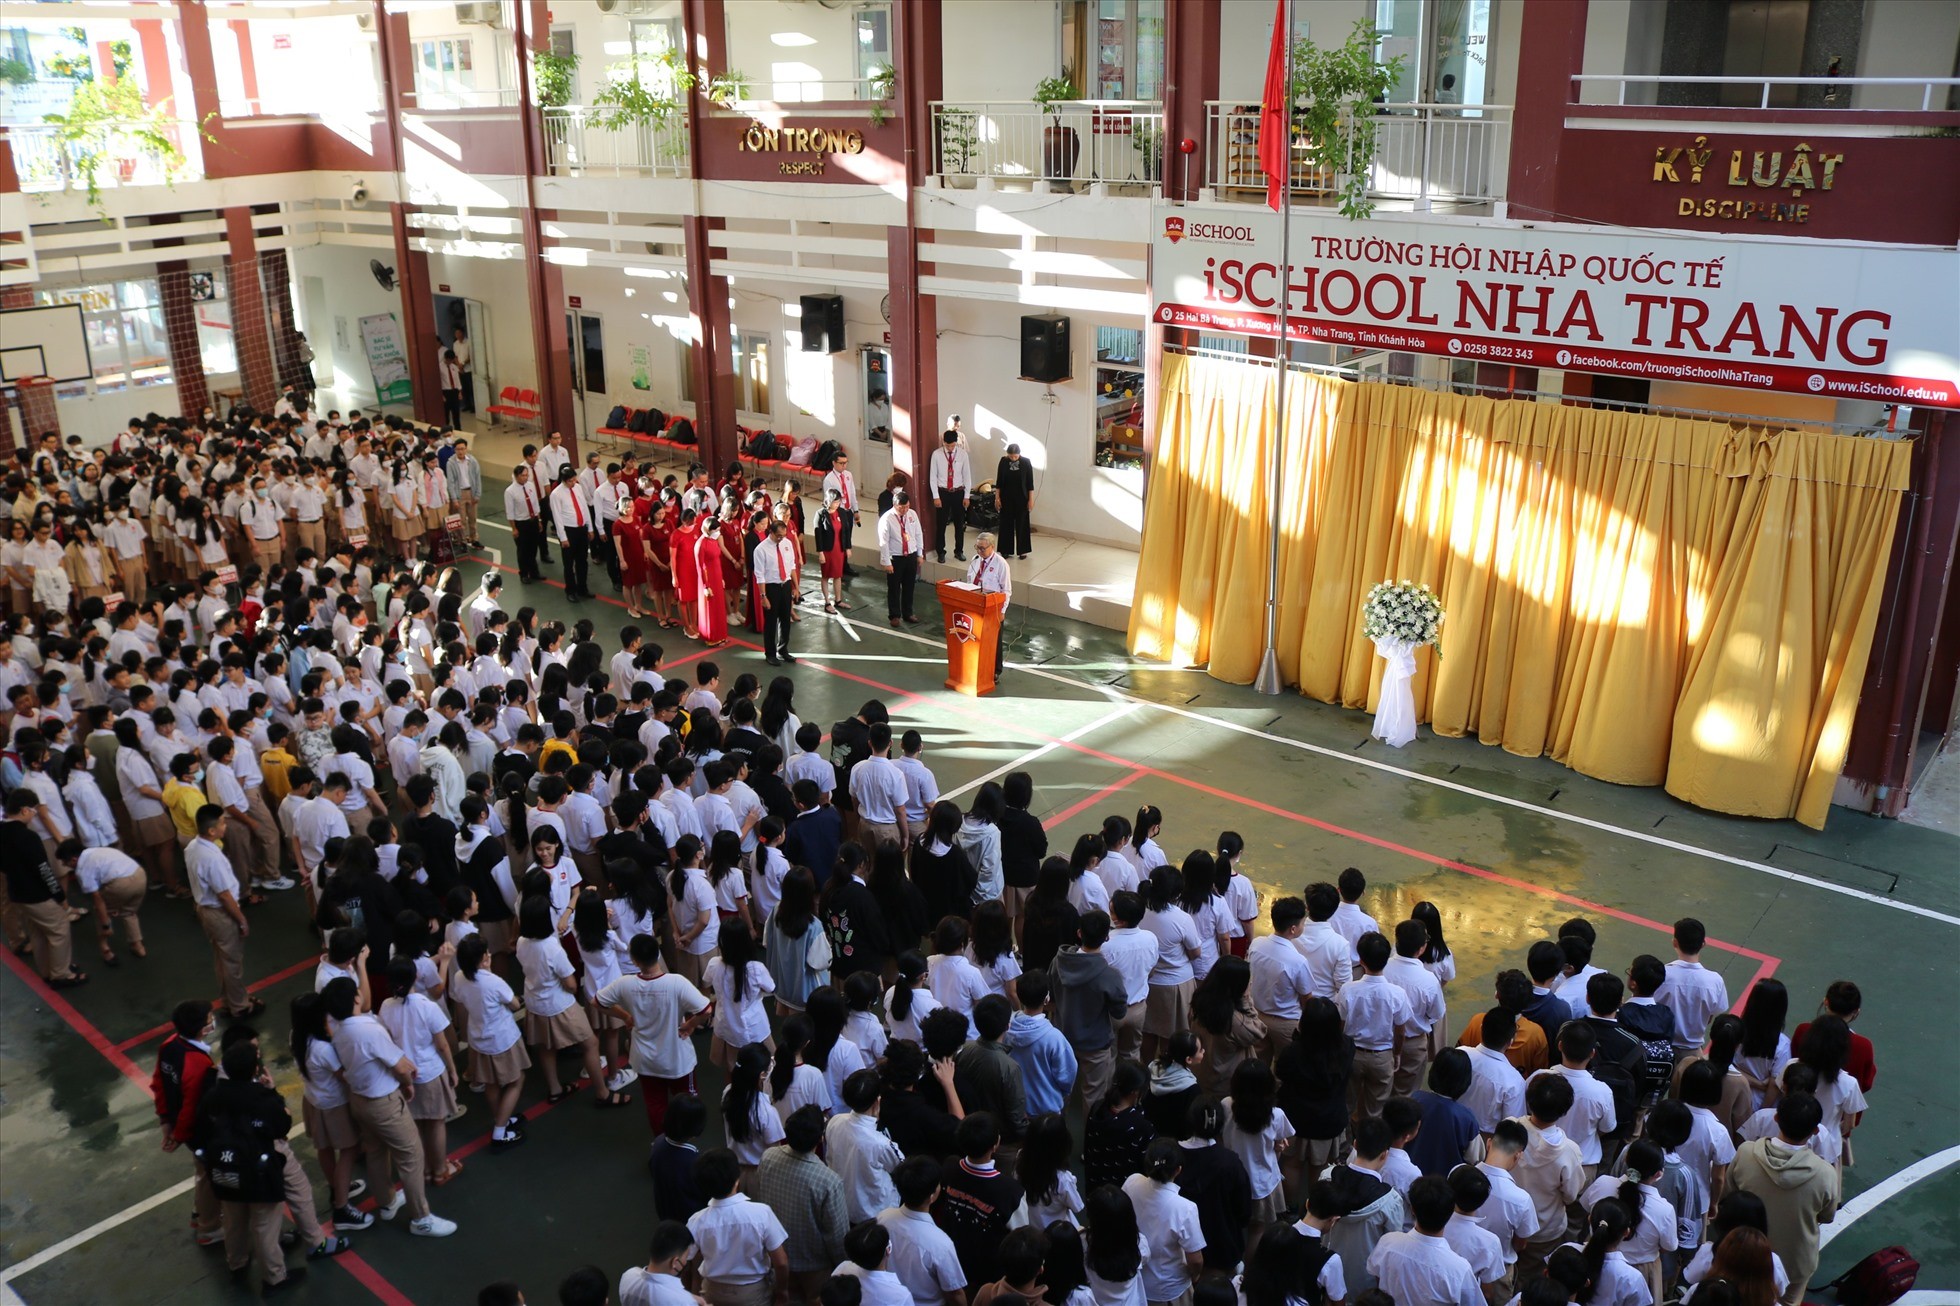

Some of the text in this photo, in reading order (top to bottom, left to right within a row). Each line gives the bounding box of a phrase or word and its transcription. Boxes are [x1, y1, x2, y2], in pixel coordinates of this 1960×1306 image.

[783, 127, 865, 160] TRỌNG
[779, 161, 825, 176] RESPECT
[1653, 135, 1844, 198] KỶ LUẬT
[1678, 197, 1811, 223] DISCIPLINE
[1189, 223, 1255, 242] iSCHOOL
[1311, 235, 1726, 289] TRƯỜNG HỘI NHẬP QUỐC TẾ
[1204, 257, 1892, 366] iSCHOOL NHA TRANG
[1175, 311, 1185, 321] 25
[1186, 312, 1199, 322] Hai
[1298, 324, 1310, 335] TP.
[1312, 326, 1328, 337] Nha
[1330, 328, 1356, 341] Trang,
[1358, 330, 1376, 343] Tỉnh
[1378, 333, 1406, 346] Khánh
[1408, 337, 1426, 348] Hòa
[1464, 343, 1534, 360] 0258 3822 343
[1572, 353, 1774, 387] facebook.com/truongiSchoolNhaTrang
[1828, 378, 1948, 402] www.iSchool.edu.vn
